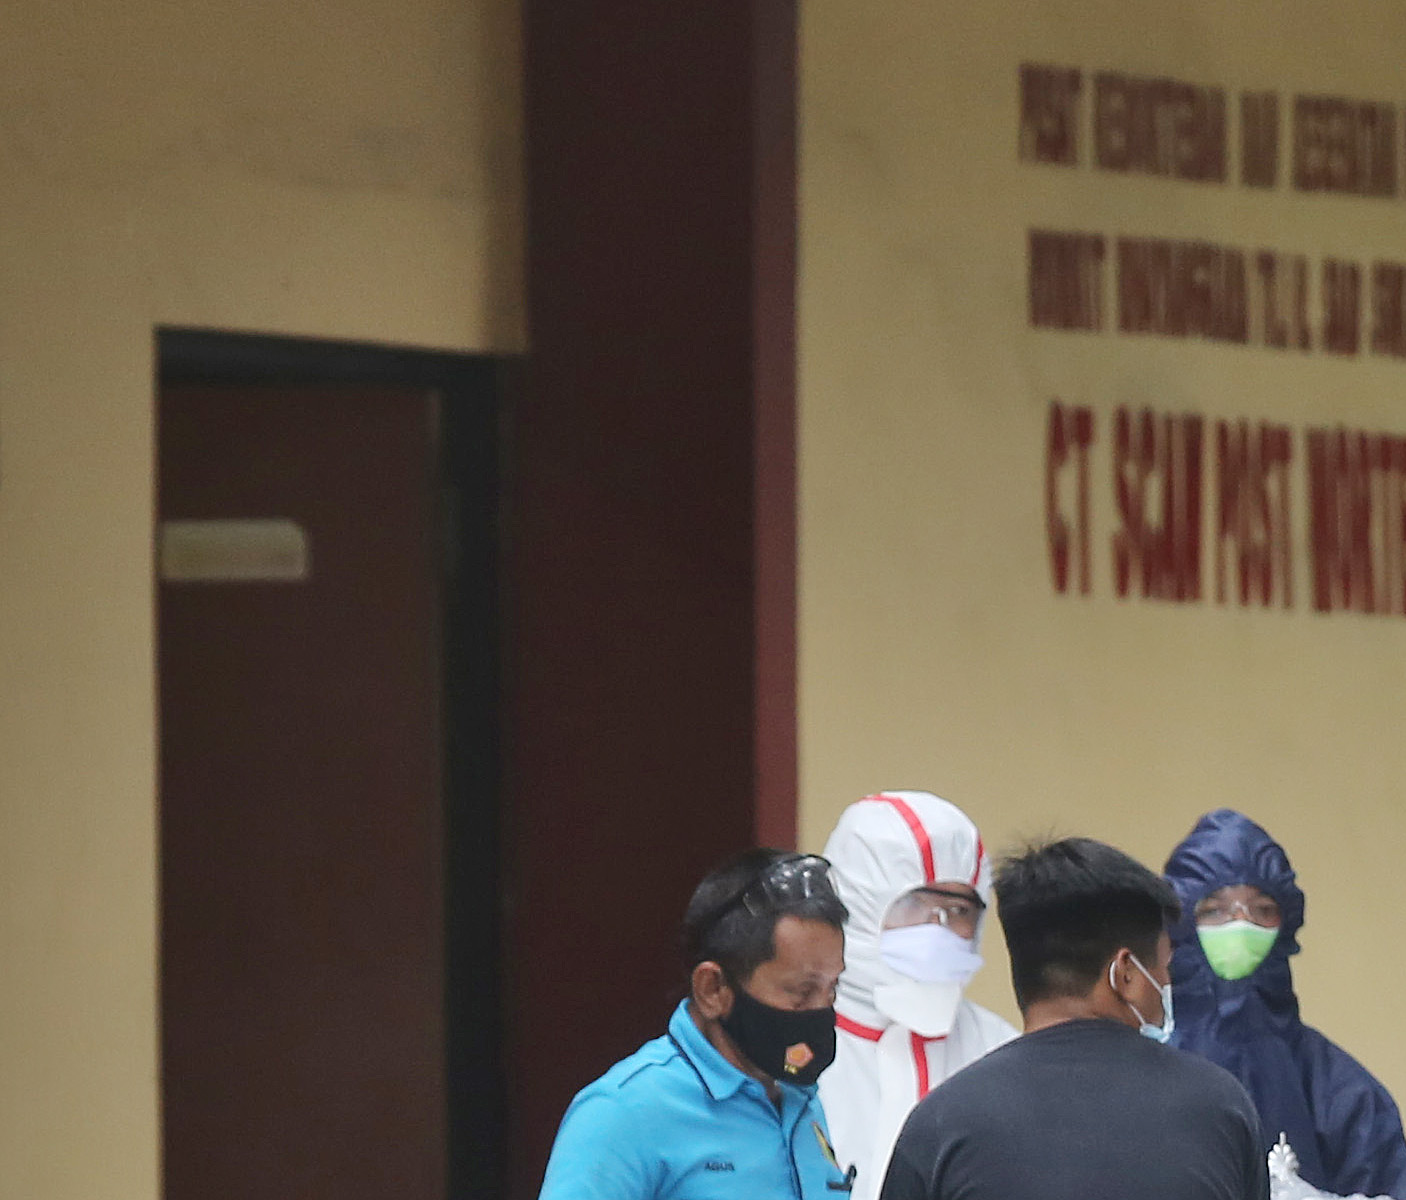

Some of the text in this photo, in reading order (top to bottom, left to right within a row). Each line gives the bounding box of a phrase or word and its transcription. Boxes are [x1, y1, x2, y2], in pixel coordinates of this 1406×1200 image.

[1044, 396, 1094, 597] CT
[1110, 404, 1204, 604] SCAN
[1214, 416, 1294, 611] POST
